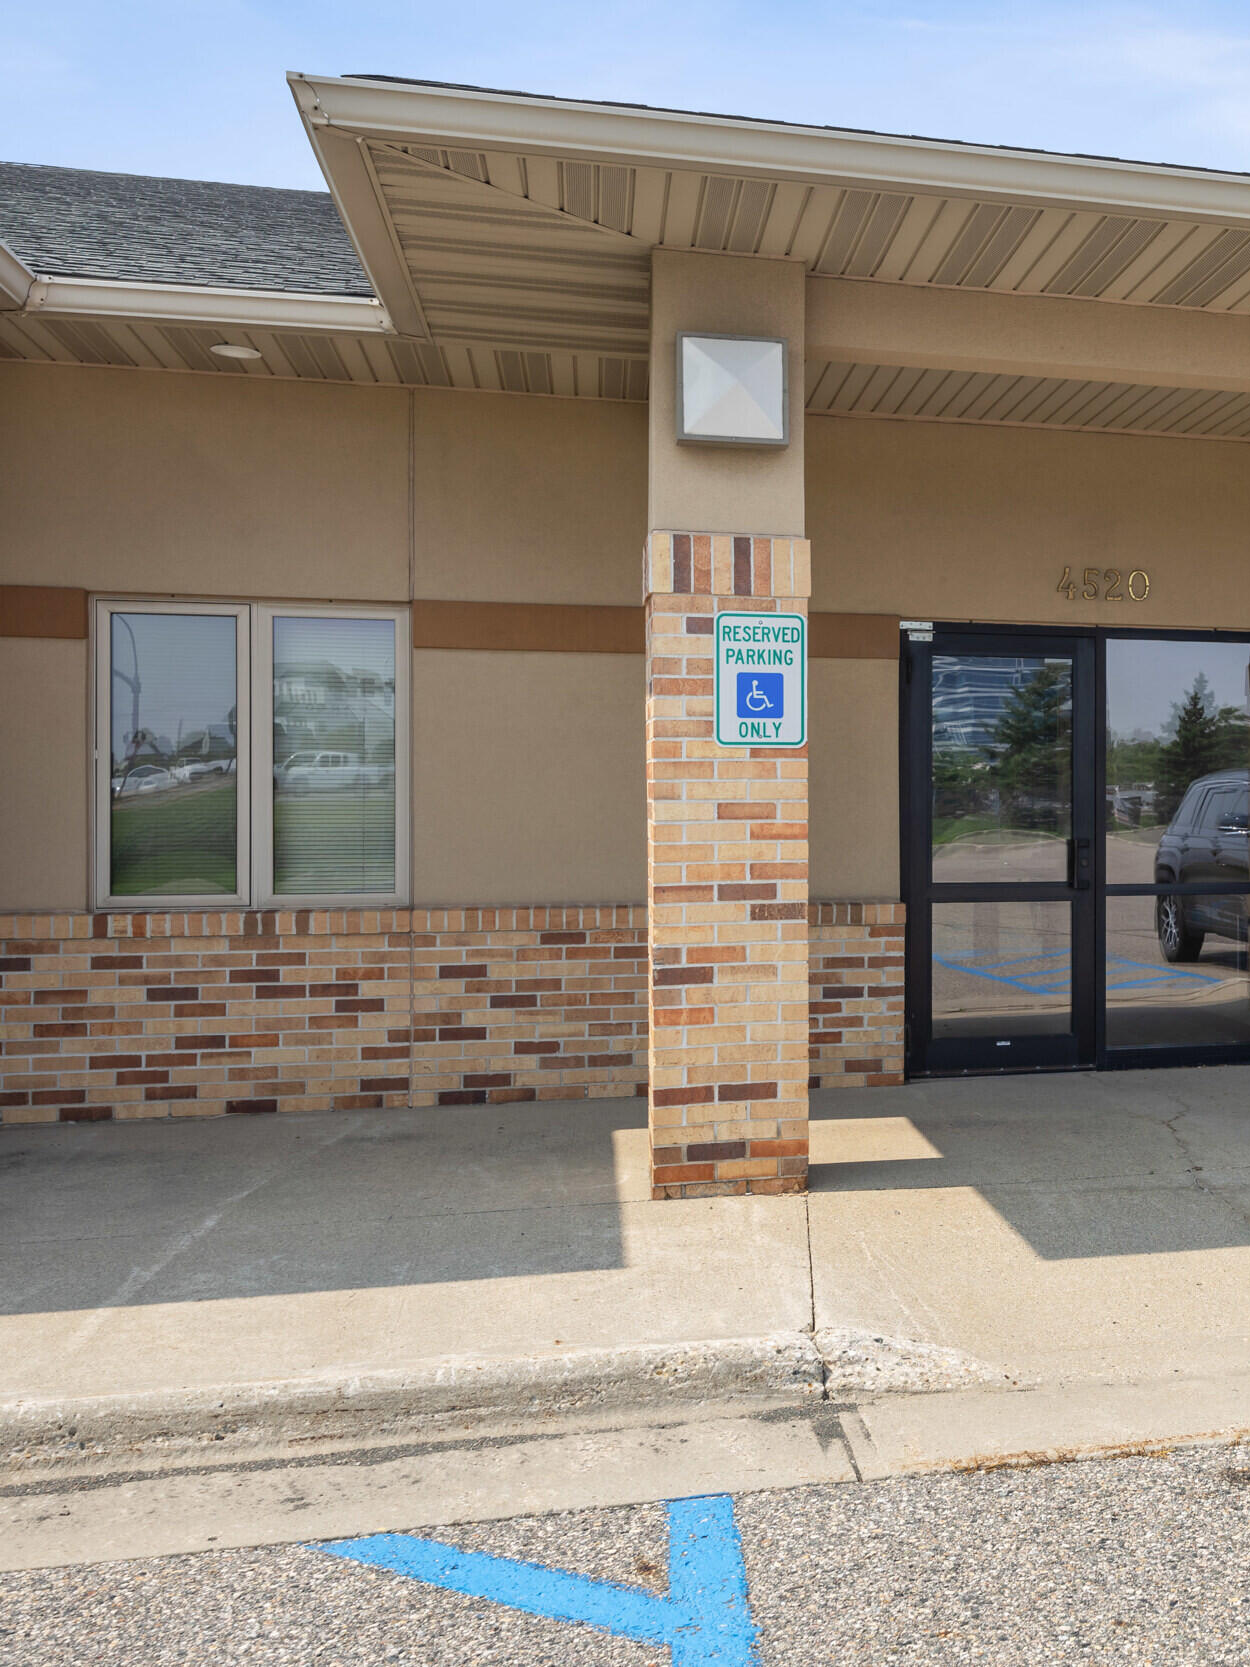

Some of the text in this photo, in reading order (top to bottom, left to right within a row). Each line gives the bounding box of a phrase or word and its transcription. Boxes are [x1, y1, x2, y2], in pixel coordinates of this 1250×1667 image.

[1056, 567, 1150, 601] 4520
[722, 625, 801, 643] RESERVED
[725, 648, 794, 666] PARKING
[739, 721, 782, 739] ONLY
